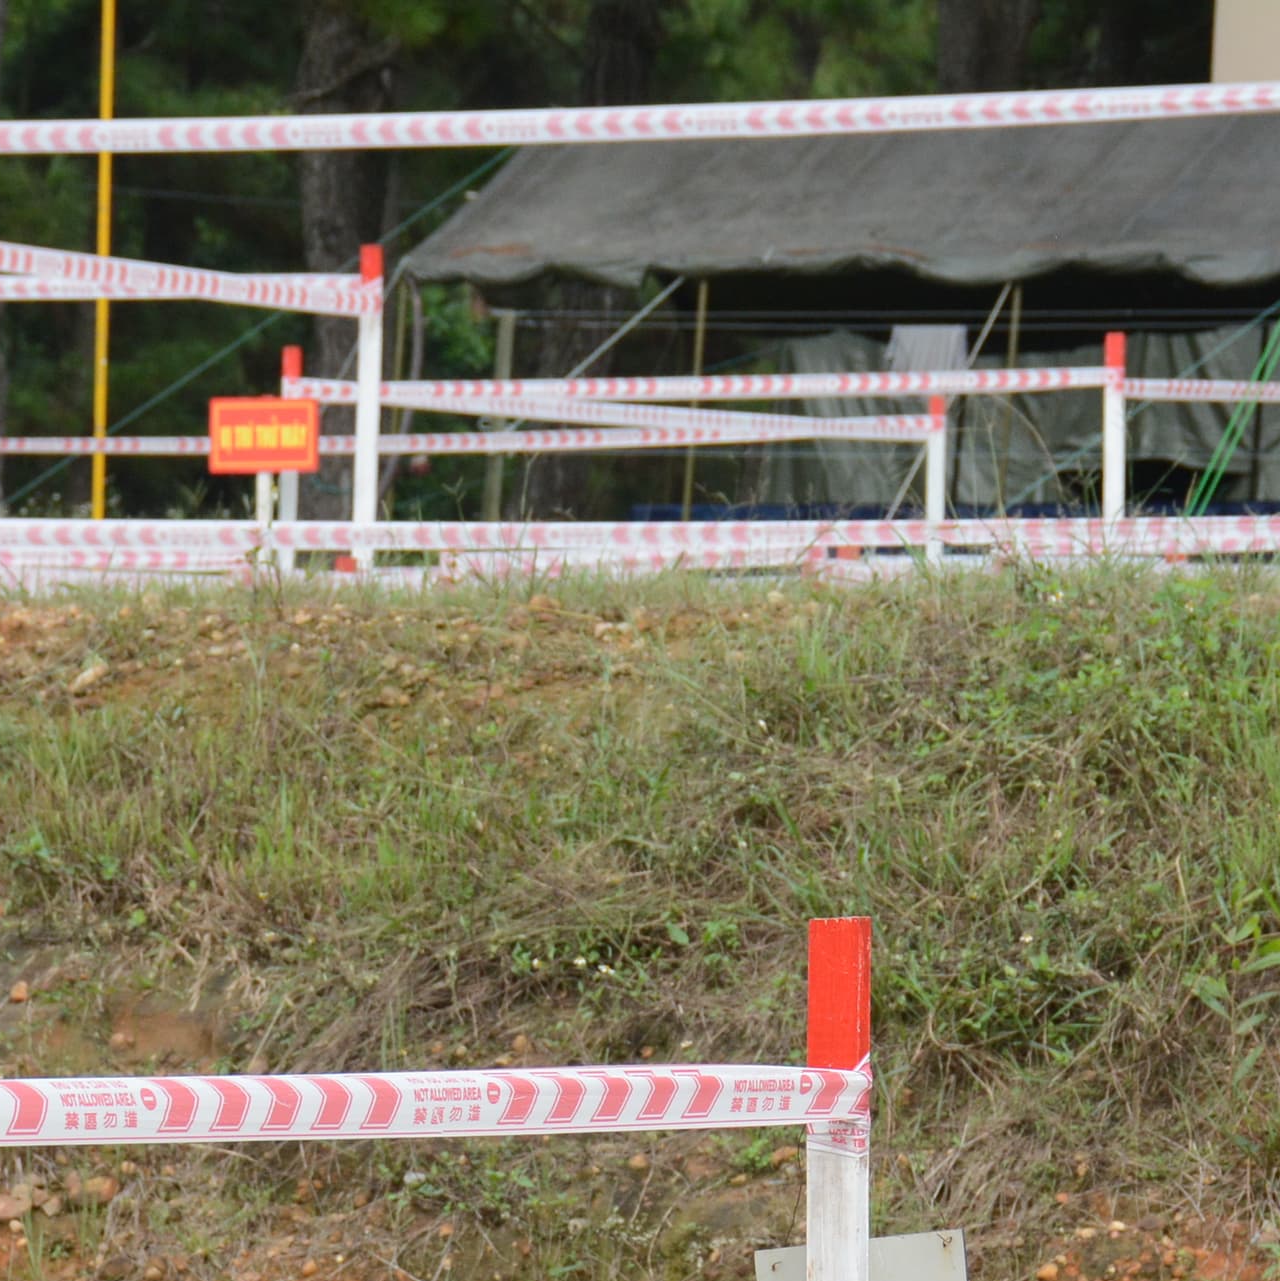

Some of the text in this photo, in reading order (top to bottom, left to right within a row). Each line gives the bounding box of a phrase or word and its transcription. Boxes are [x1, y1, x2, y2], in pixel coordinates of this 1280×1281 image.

[414, 1087, 482, 1102] NOT ALLOWED AREA
